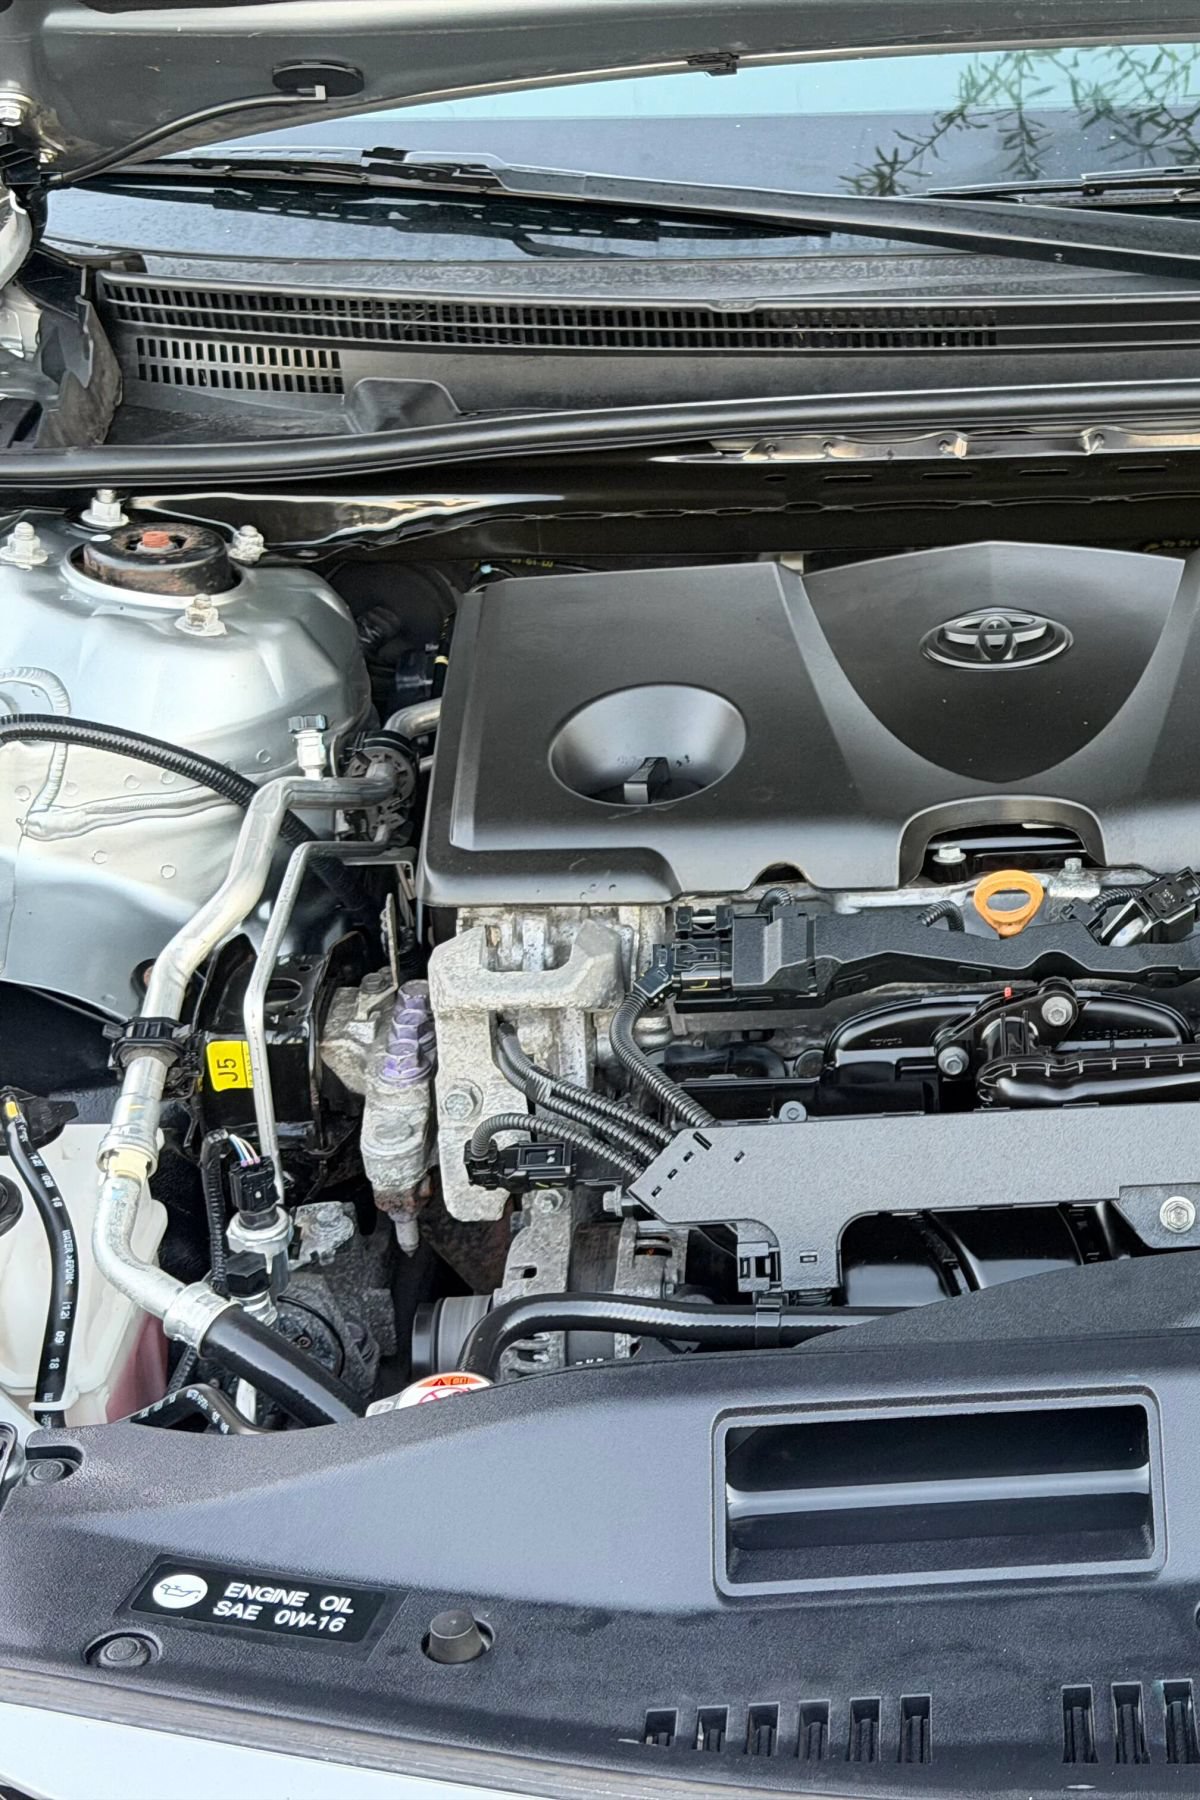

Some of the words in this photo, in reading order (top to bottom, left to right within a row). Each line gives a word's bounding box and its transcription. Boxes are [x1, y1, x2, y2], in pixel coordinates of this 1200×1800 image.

[216, 1058, 239, 1082] J5
[62, 1229, 74, 1255] WATER
[49, 1357, 60, 1370] 18
[224, 1582, 309, 1607] ENGINE
[319, 1595, 355, 1614] OIL
[213, 1601, 263, 1621] SAE
[274, 1610, 346, 1633] 0W-16
